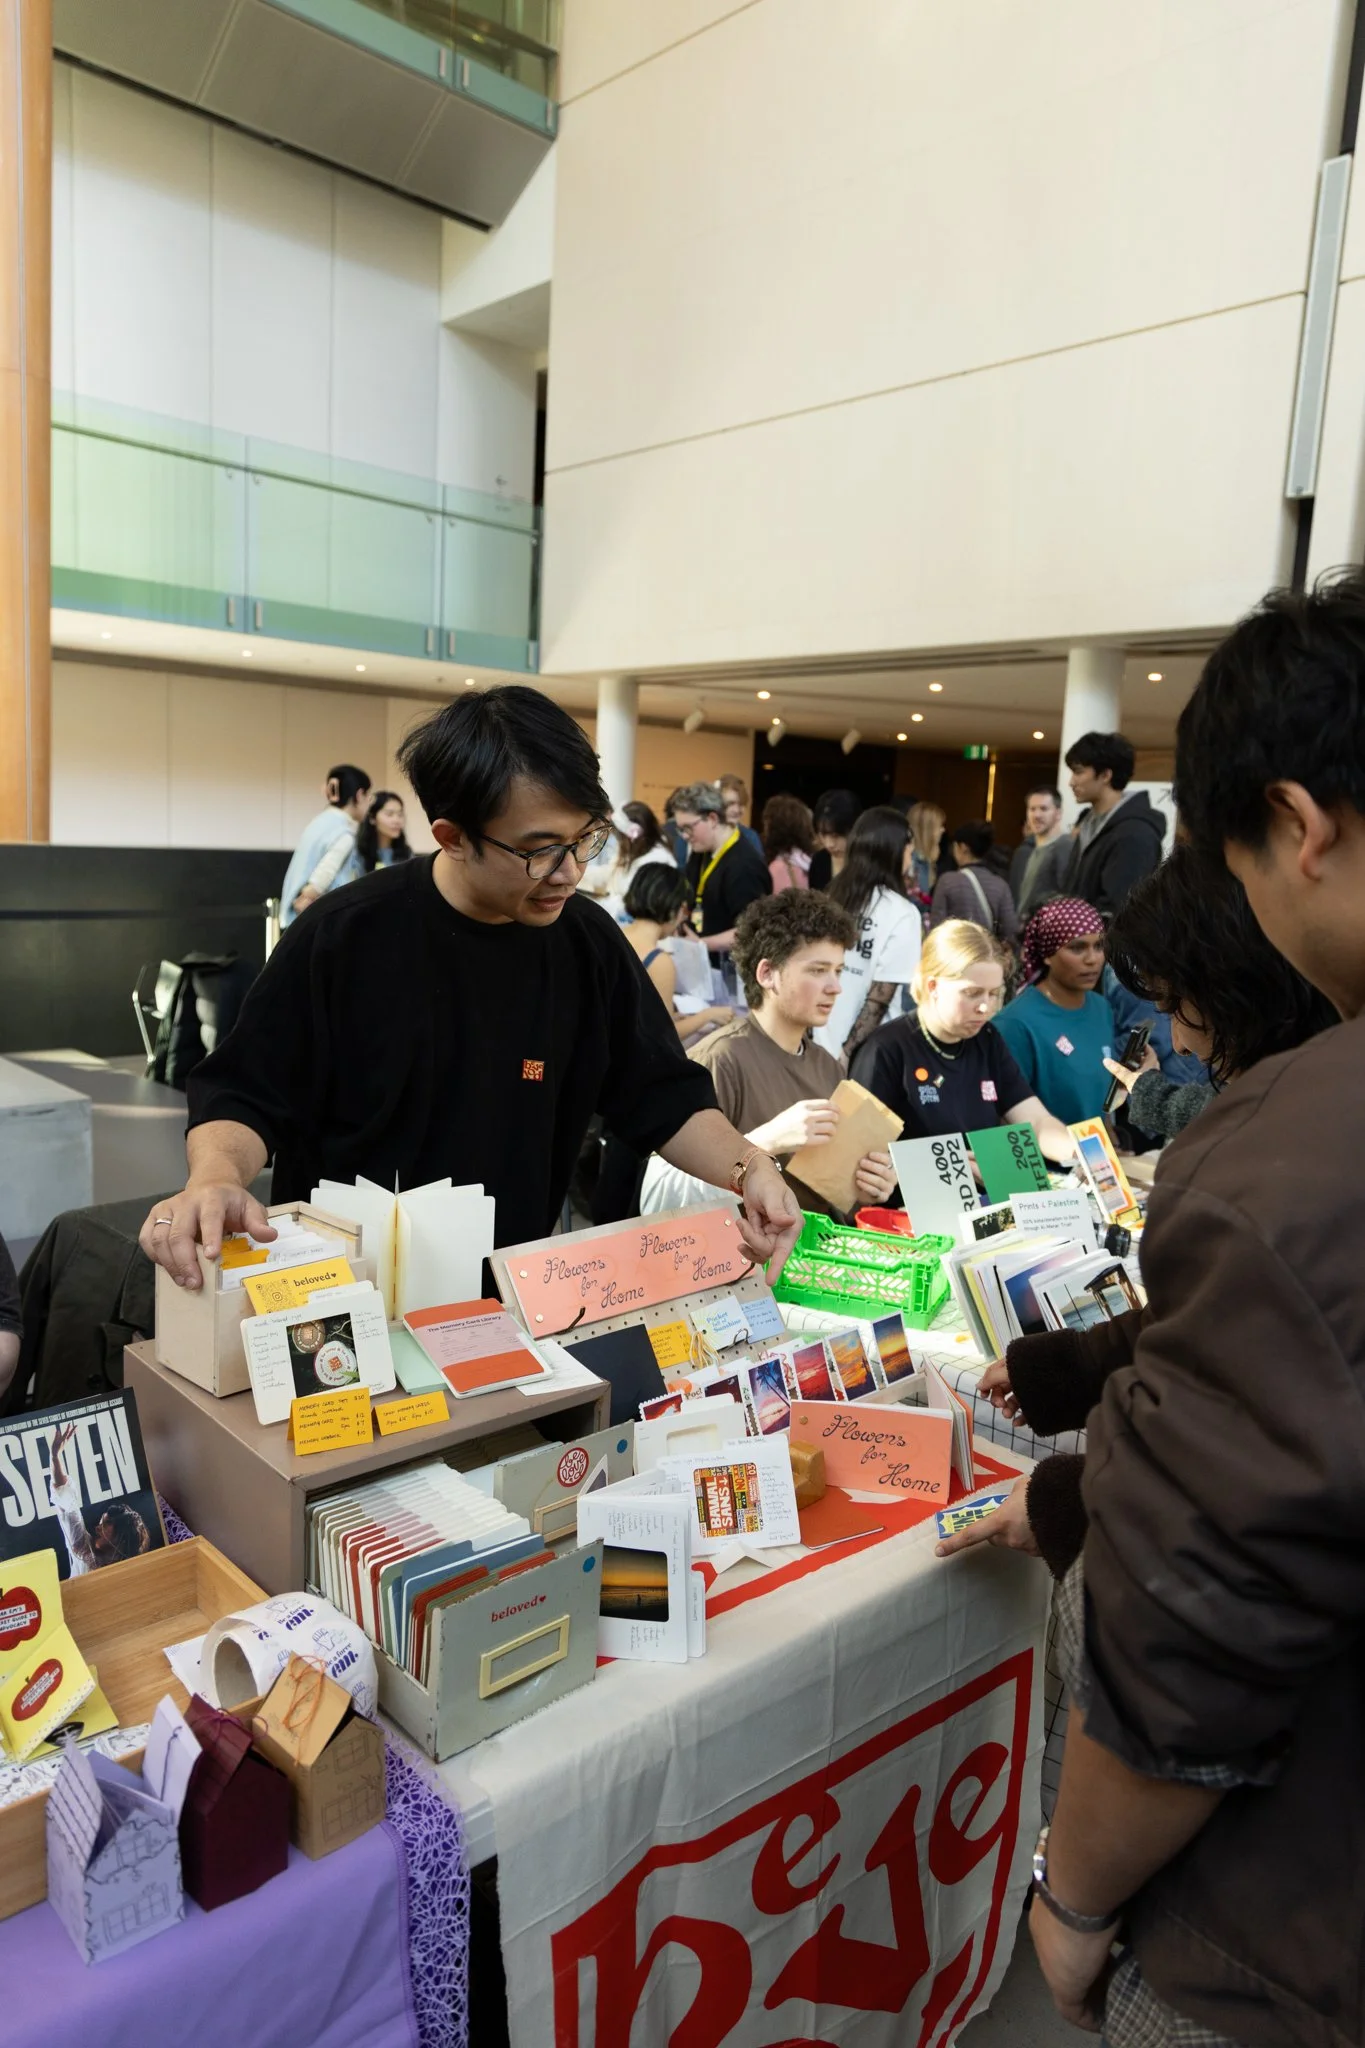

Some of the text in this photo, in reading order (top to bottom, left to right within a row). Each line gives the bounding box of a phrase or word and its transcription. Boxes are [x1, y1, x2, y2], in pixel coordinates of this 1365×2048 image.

[931, 1142, 952, 1186] 400
[946, 1139, 968, 1180] XP2
[1007, 1131, 1028, 1170] 200
[1048, 1199, 1079, 1208] Palestine
[640, 1232, 696, 1258] Flowers
[543, 1256, 606, 1284] Flowers
[674, 1251, 689, 1271] for
[692, 1256, 732, 1281] Home
[294, 1272, 331, 1287] beloved
[581, 1276, 598, 1297] for
[601, 1281, 645, 1308] Home
[440, 1321, 465, 1330] Memory
[706, 1311, 728, 1324] Pocket
[822, 1414, 907, 1447] Flowers
[0, 1406, 141, 1527] SEVEN
[860, 1445, 887, 1465] for
[878, 1462, 941, 1494] Home
[706, 1477, 721, 1528] BAWAL
[719, 1487, 733, 1527] SANS
[491, 1595, 538, 1623] beloved
